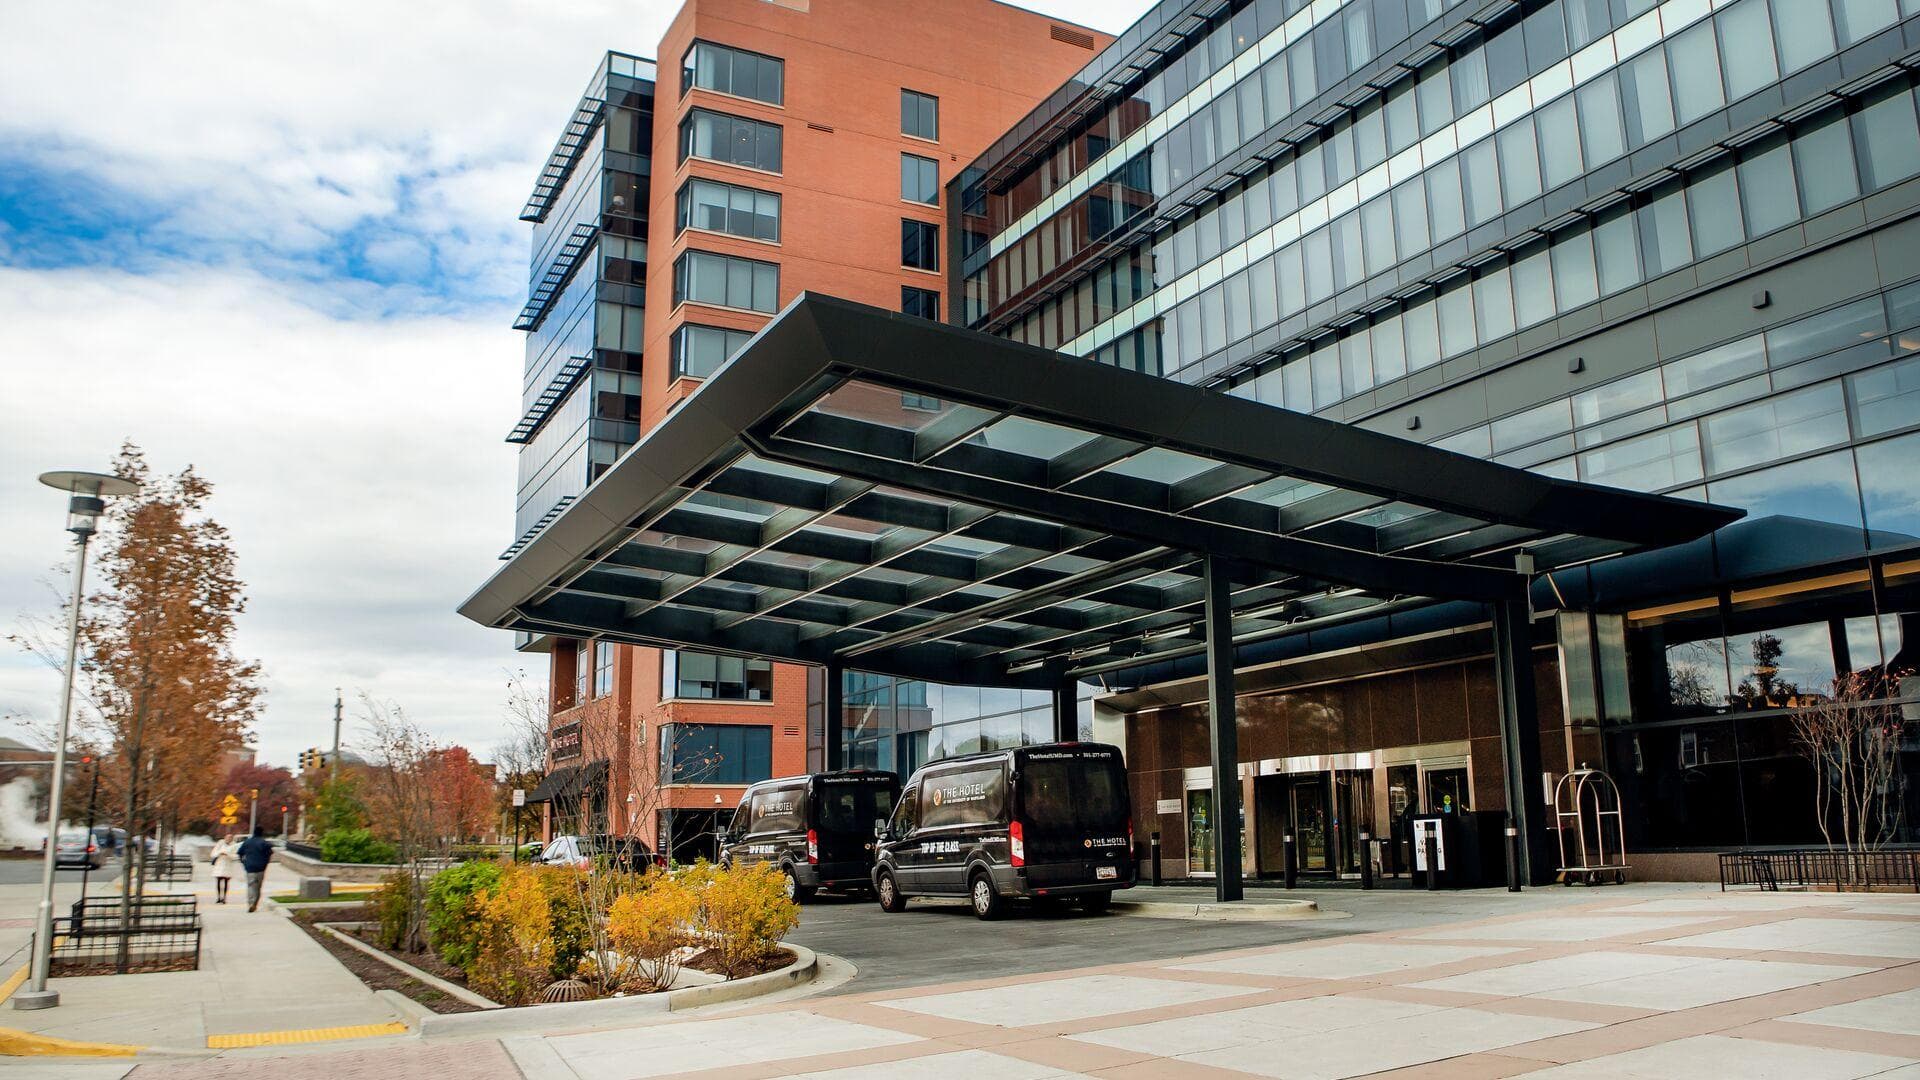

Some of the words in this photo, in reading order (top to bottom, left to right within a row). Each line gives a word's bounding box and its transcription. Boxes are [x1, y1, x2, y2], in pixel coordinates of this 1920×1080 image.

[943, 788, 957, 798] THE
[960, 784, 985, 795] HOTEL
[764, 804, 775, 812] THE
[776, 802, 793, 811] HOTEL
